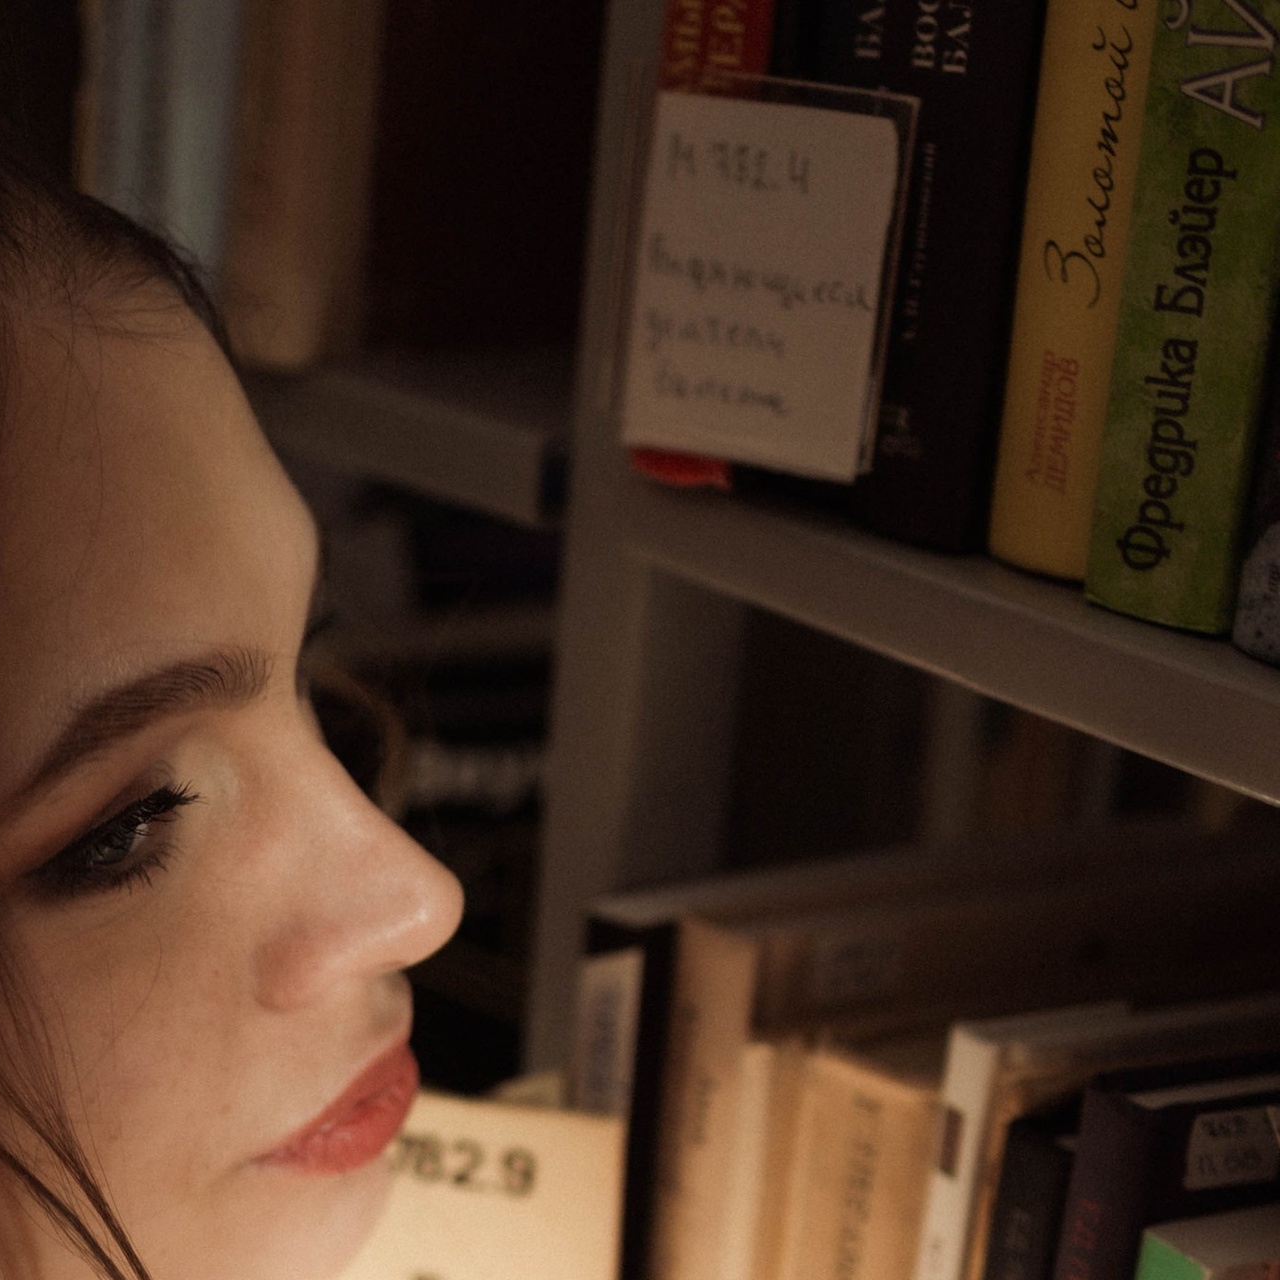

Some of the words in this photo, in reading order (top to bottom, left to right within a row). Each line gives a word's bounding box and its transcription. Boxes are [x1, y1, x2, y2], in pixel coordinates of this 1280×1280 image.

[1043, 26, 1132, 309] Золотой
[1153, 147, 1236, 317] Блэйер
[1044, 358, 1080, 495] ДЕМИДОВ
[1116, 338, 1199, 571] Фредрика
